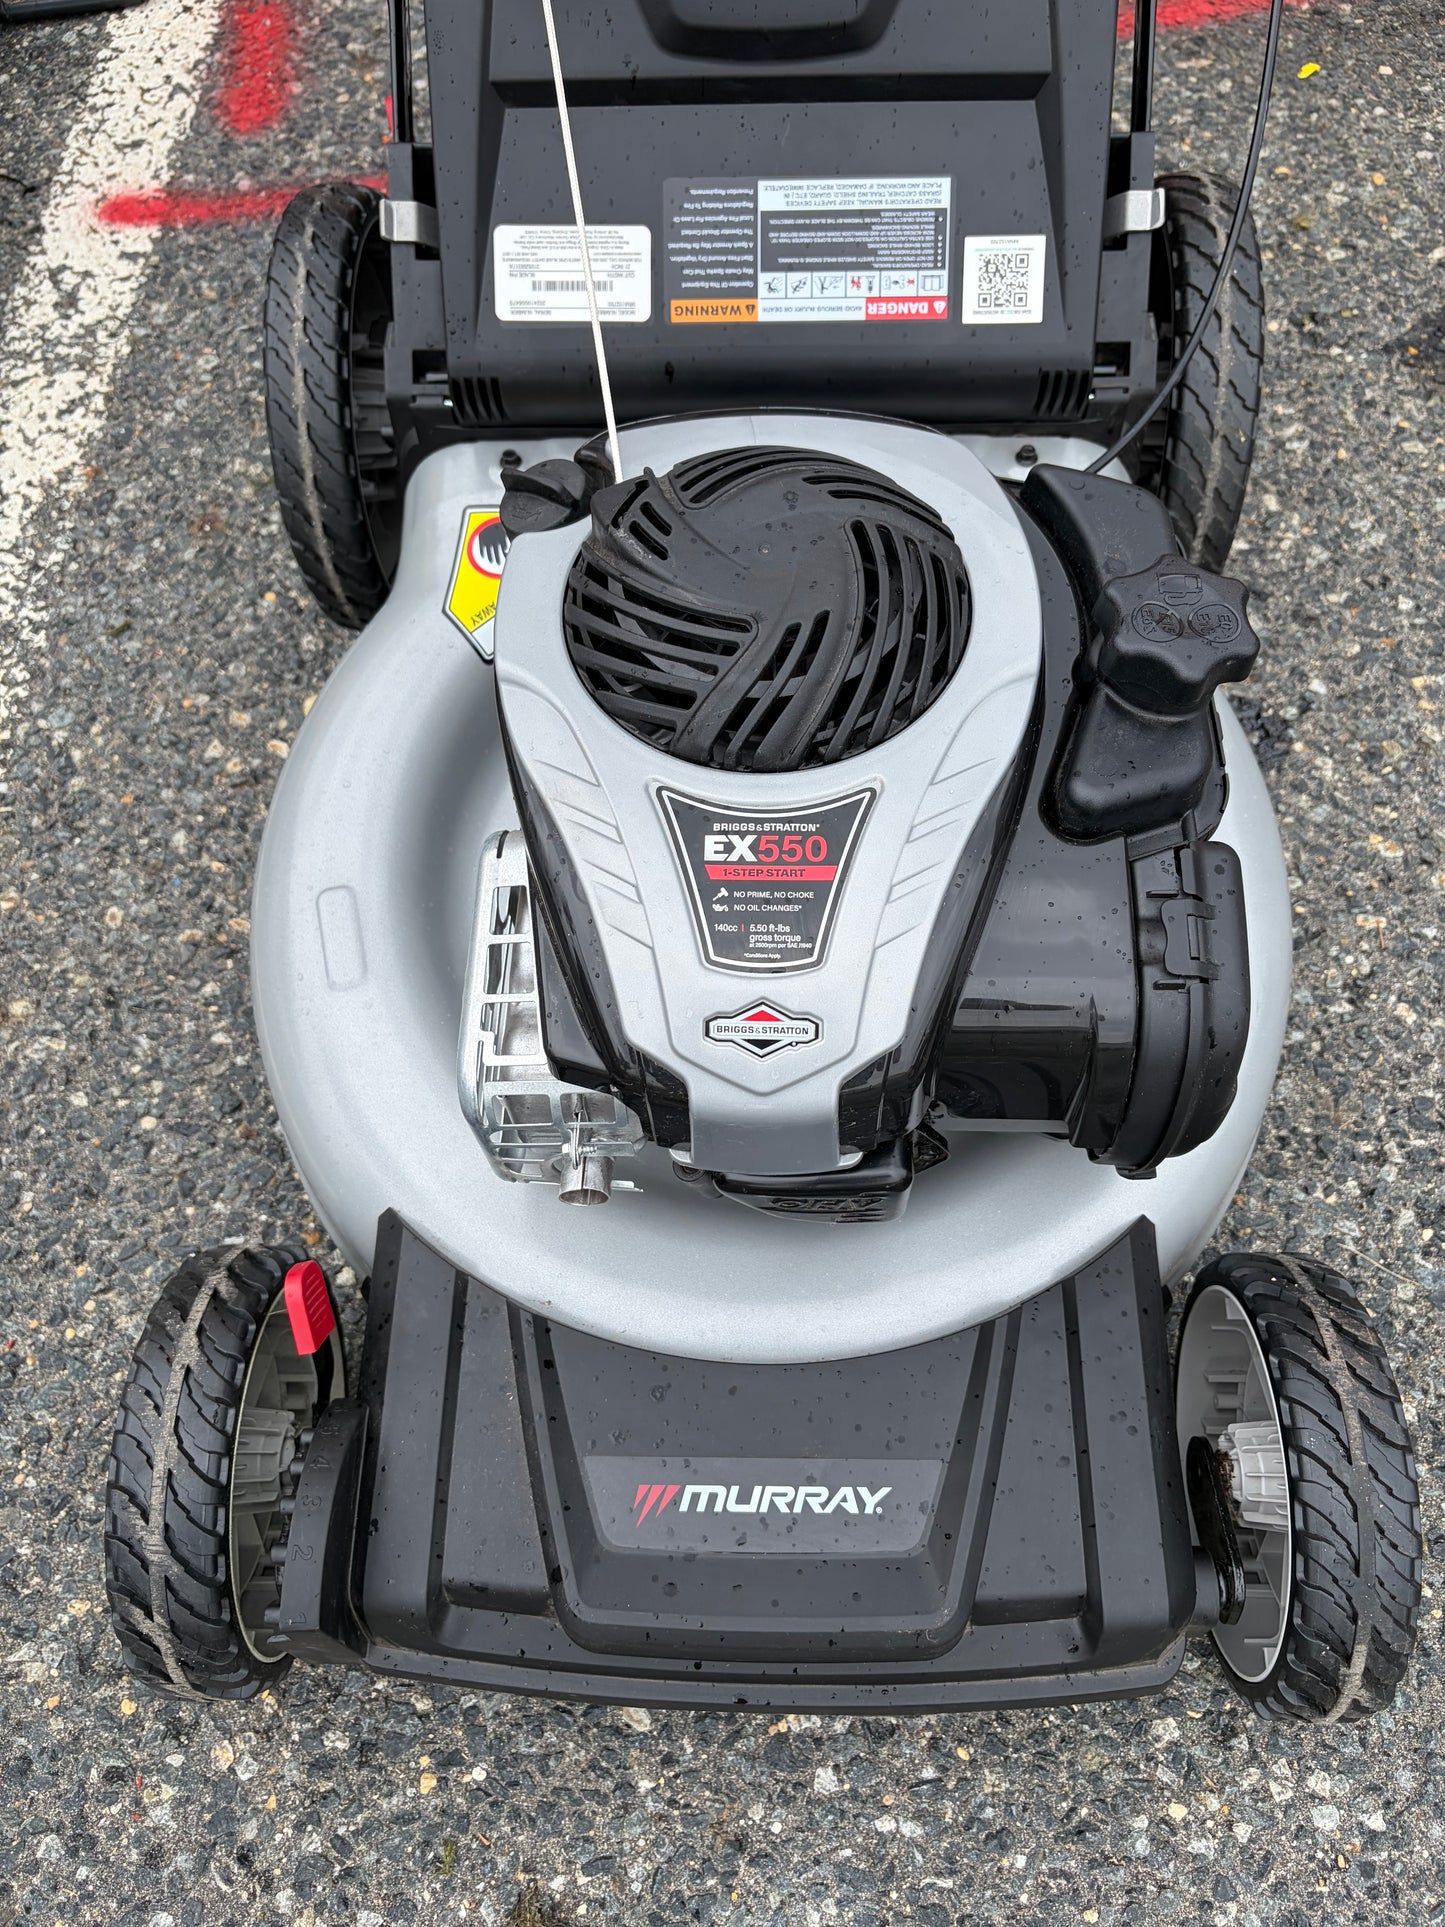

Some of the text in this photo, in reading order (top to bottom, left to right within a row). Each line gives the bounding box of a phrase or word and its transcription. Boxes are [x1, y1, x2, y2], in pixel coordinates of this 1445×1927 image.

[674, 305, 741, 316] WARNING
[867, 302, 928, 314] DANGER
[470, 601, 496, 626] AWAY
[704, 834, 828, 862] EX550
[723, 868, 805, 877] 1-STEP START
[733, 891, 814, 900] NO PRIME, NO CHOKE
[733, 904, 745, 912] NO
[747, 904, 760, 912] OIL
[714, 924, 790, 932] 140cc 5.50 ft-lbs
[749, 933, 801, 943] gross torque
[301, 1494, 323, 1509] 3
[678, 1484, 893, 1514] MURRAY
[291, 1543, 314, 1562] 2
